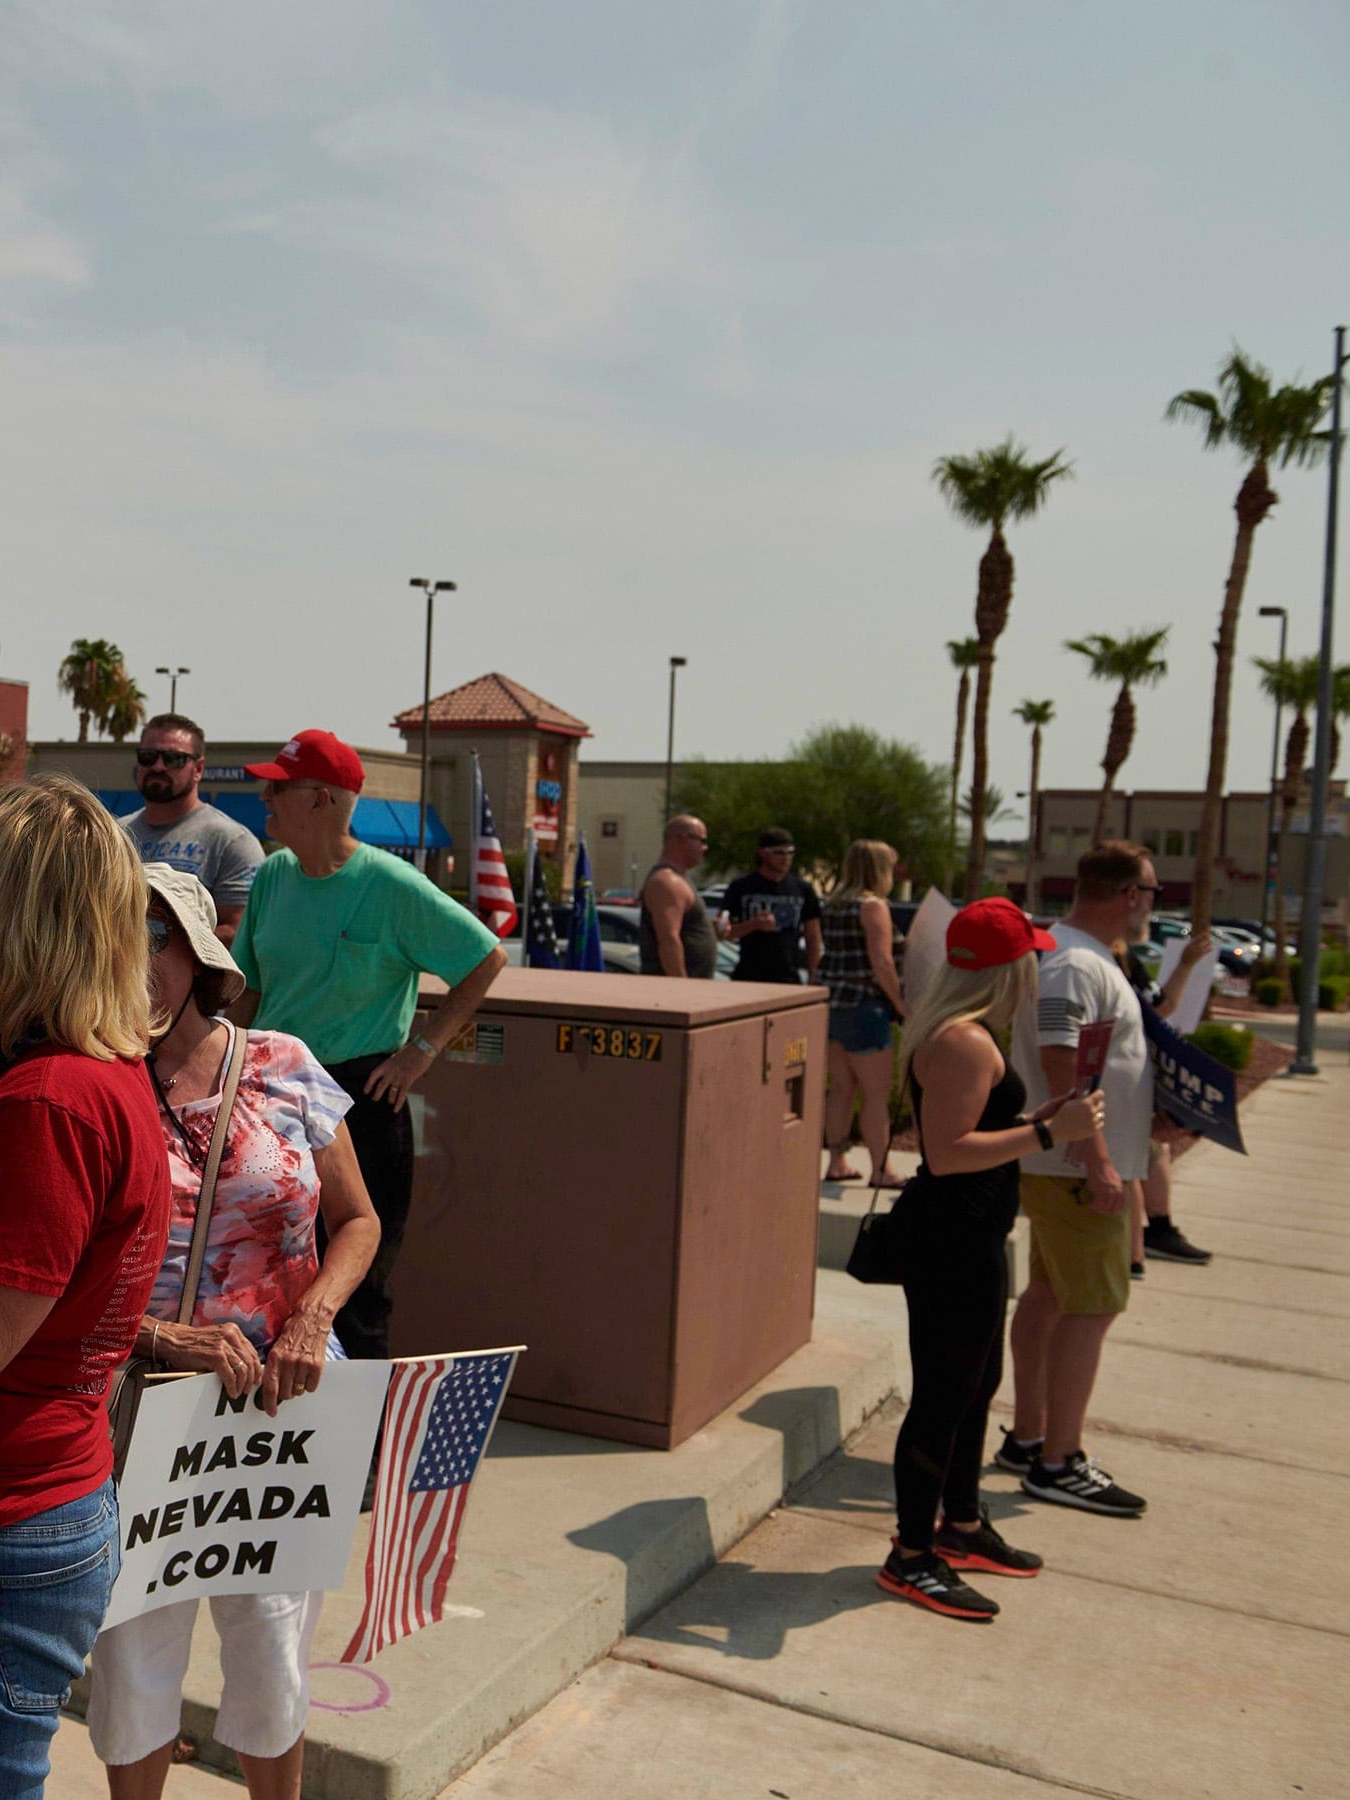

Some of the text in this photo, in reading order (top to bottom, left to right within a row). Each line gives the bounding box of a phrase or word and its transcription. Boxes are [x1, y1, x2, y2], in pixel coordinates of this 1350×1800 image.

[202, 767, 246, 781] AURANT
[559, 1024, 662, 1060] F3837
[168, 1429, 316, 1482] MASK
[125, 1484, 331, 1551] NEVADA
[145, 1540, 278, 1595] .COM
